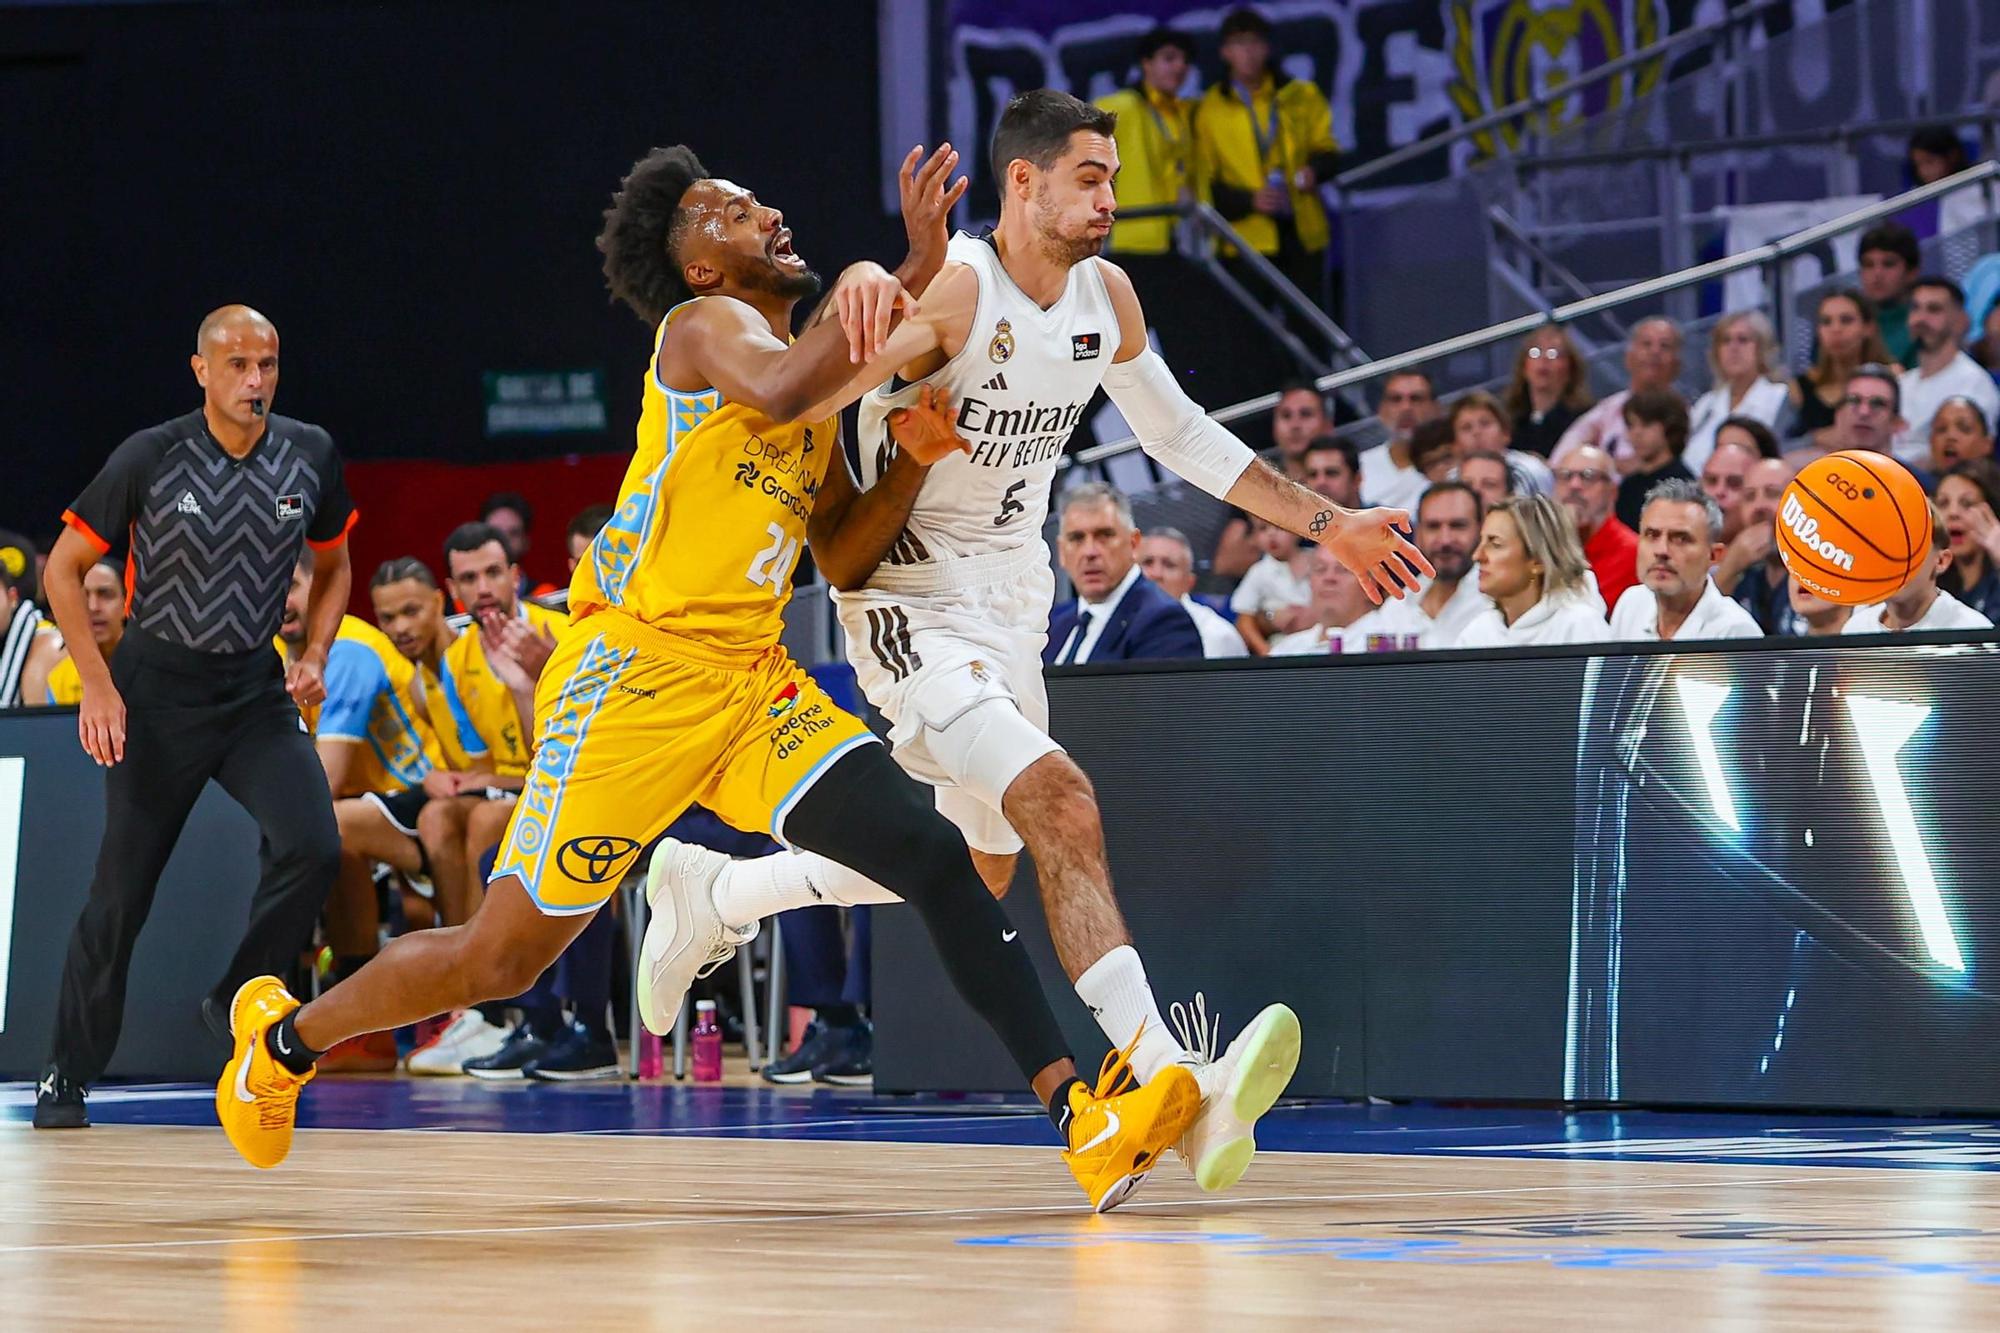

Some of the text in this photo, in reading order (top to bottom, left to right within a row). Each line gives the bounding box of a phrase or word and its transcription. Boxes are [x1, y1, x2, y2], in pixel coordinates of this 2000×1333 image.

[969, 440, 1012, 468] FLY
[177, 501, 202, 515] PEAK
[993, 479, 1027, 526] 5
[1826, 472, 1859, 501] acb
[1781, 492, 1854, 571] Wilson
[745, 521, 798, 598] 24
[777, 716, 835, 759] del Mar
